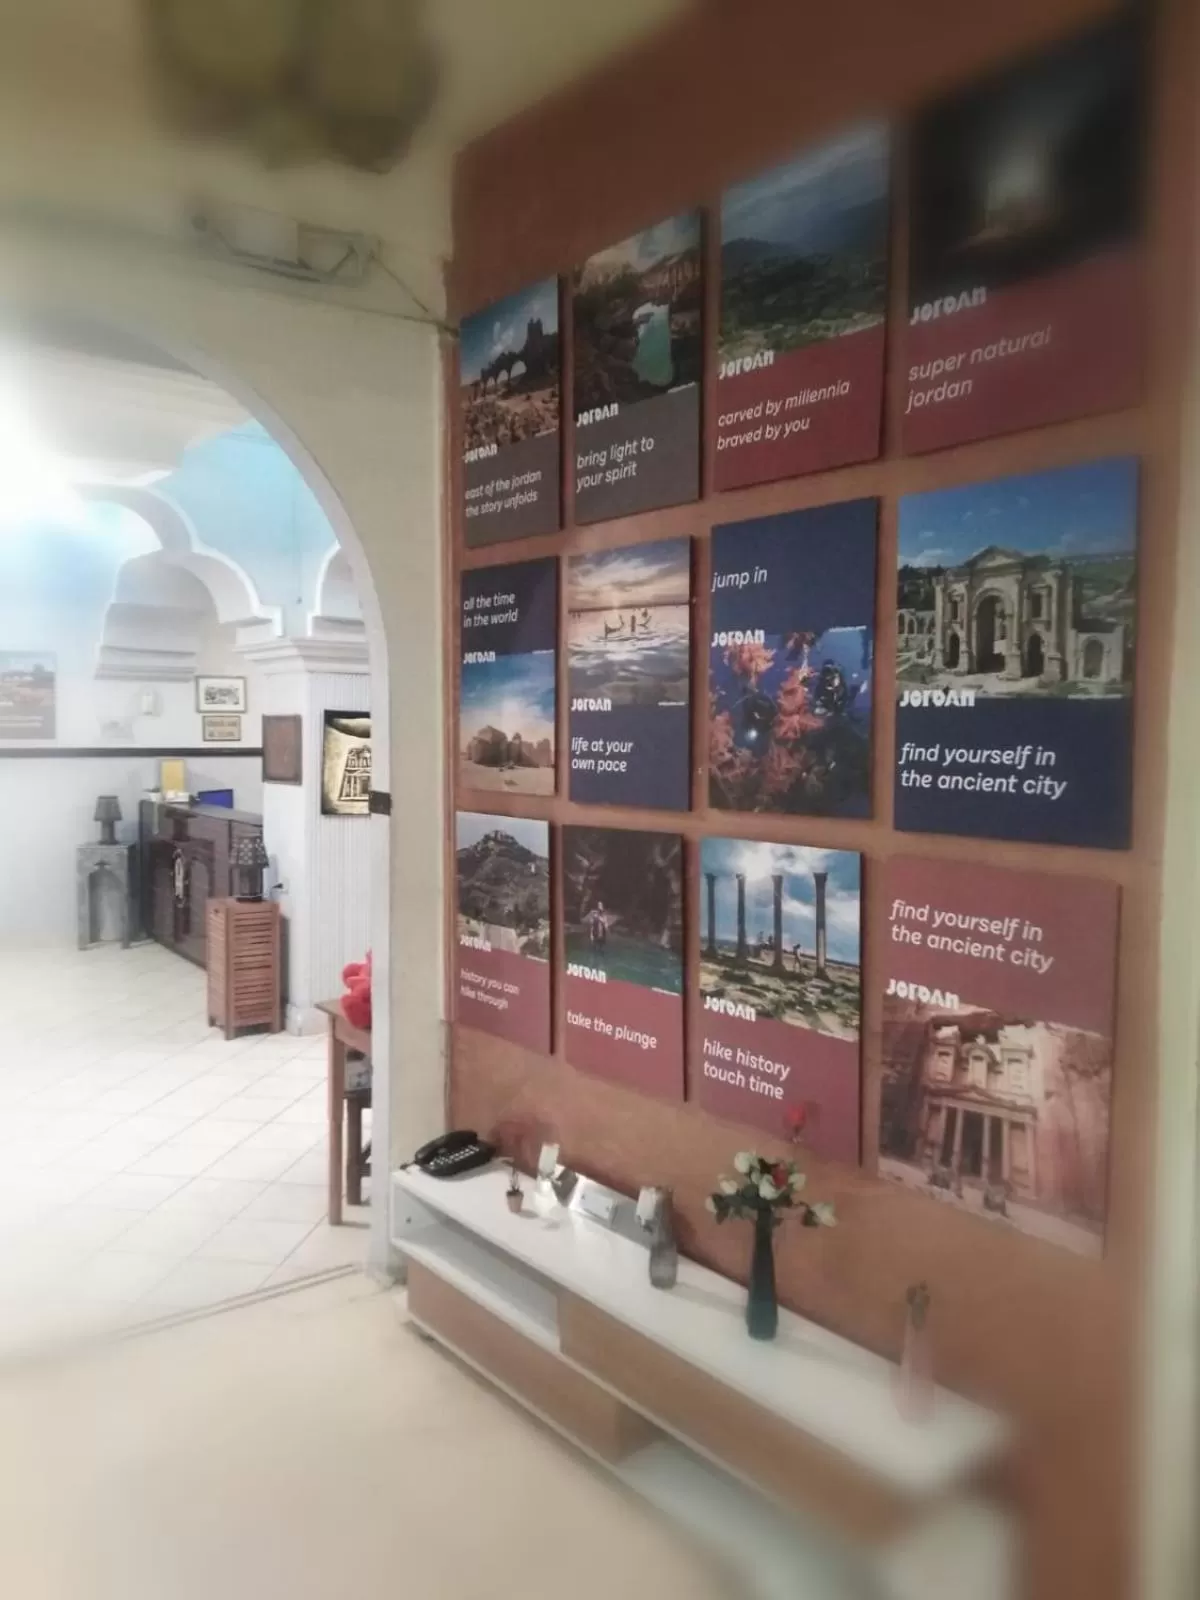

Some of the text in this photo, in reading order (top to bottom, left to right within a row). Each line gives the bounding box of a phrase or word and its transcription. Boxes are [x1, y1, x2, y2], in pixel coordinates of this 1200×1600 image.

[908, 325, 1052, 382] super natural
[718, 379, 851, 427] carved by millennia
[905, 377, 973, 415] jordan
[717, 416, 811, 451] braved by you
[577, 436, 654, 469] bring light to
[465, 470, 542, 500] east of the jordan
[576, 461, 638, 493] your spirit
[466, 489, 538, 518] the story unfolds
[711, 567, 768, 592] jump in
[463, 592, 515, 610] all the time
[463, 608, 518, 628] in the world
[572, 736, 633, 755] life at your
[898, 743, 1056, 770] find yourself in
[572, 759, 628, 774] own pace
[901, 769, 1068, 800] the ancient city
[889, 899, 1044, 942] find yourself in
[891, 924, 1055, 974] the ancient city
[487, 979, 502, 990] you
[566, 1010, 657, 1049] take the plunge
[703, 1038, 790, 1081] hike history
[703, 1061, 784, 1099] touch time
